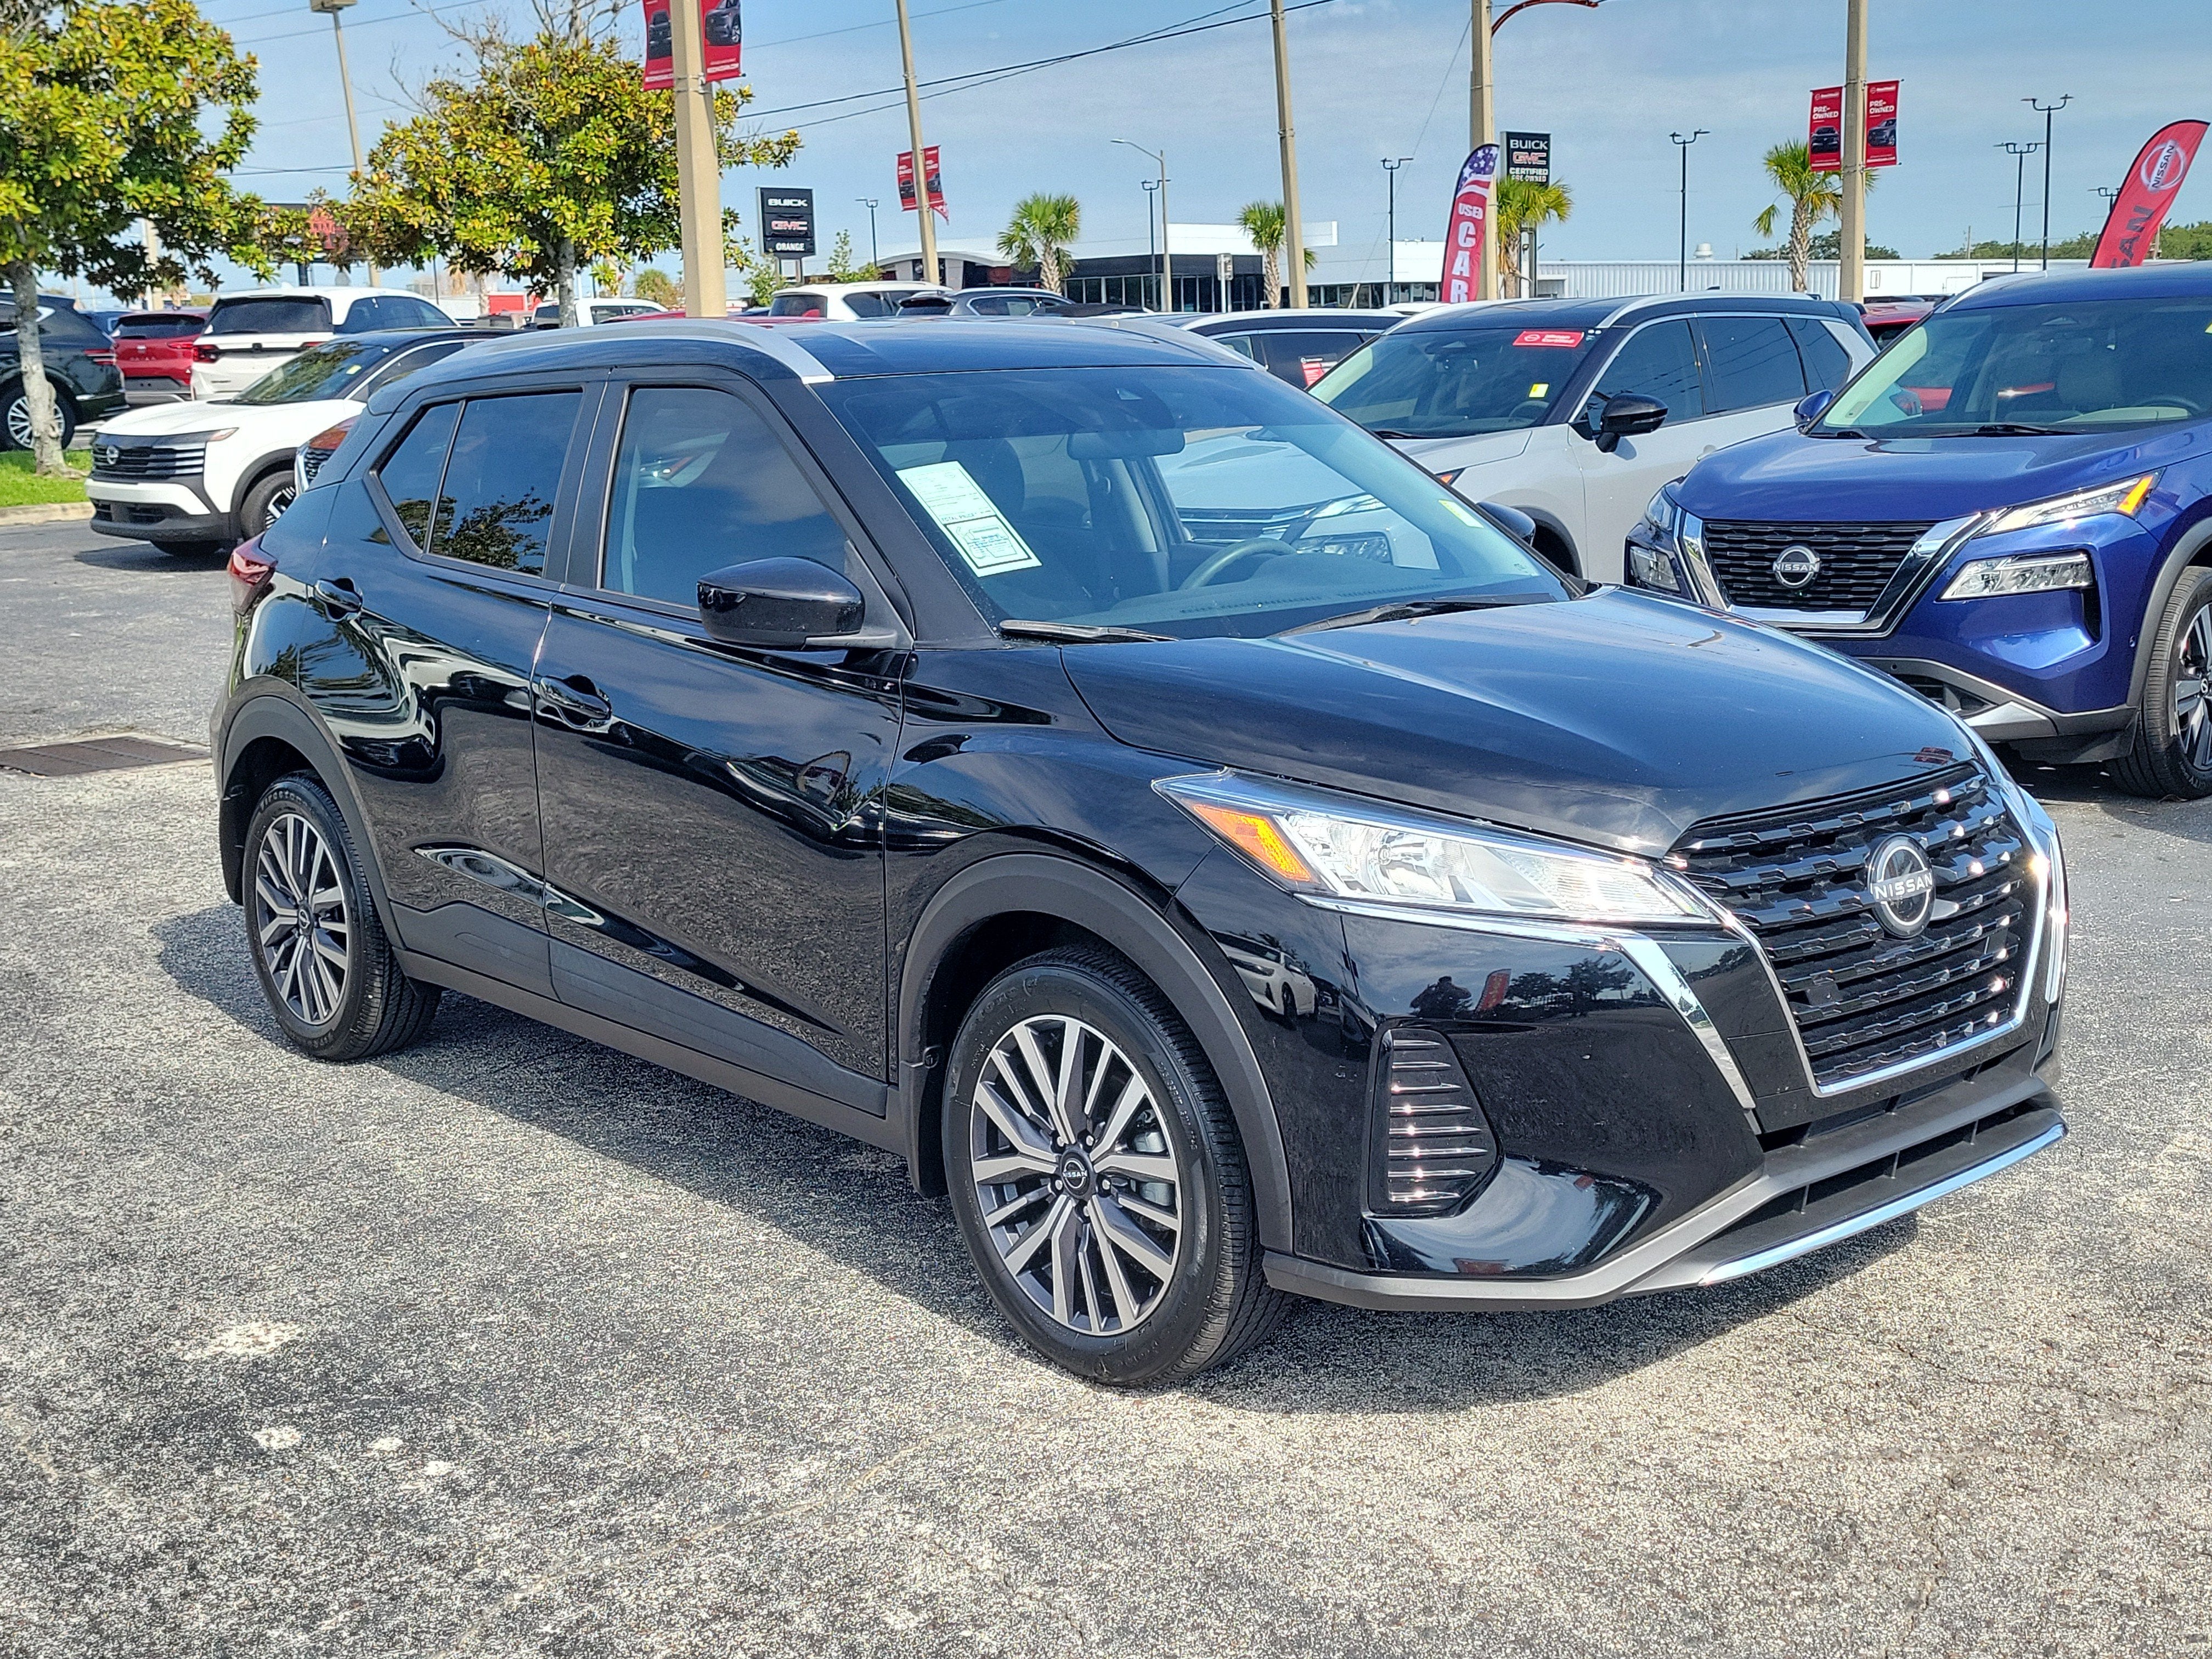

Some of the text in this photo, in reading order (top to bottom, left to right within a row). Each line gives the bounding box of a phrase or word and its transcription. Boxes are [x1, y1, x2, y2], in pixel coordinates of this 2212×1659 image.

[1510, 139, 1548, 150] BUICK
[1513, 151, 1547, 165] GMC
[2151, 144, 2175, 189] NISSAN
[768, 198, 808, 207] BUICK
[1458, 202, 1483, 219] USED
[771, 221, 808, 230] GMC
[775, 242, 805, 251] ORANGE
[1874, 872, 1933, 900] NISSAN
[1062, 1170, 1088, 1178] NISSAN
